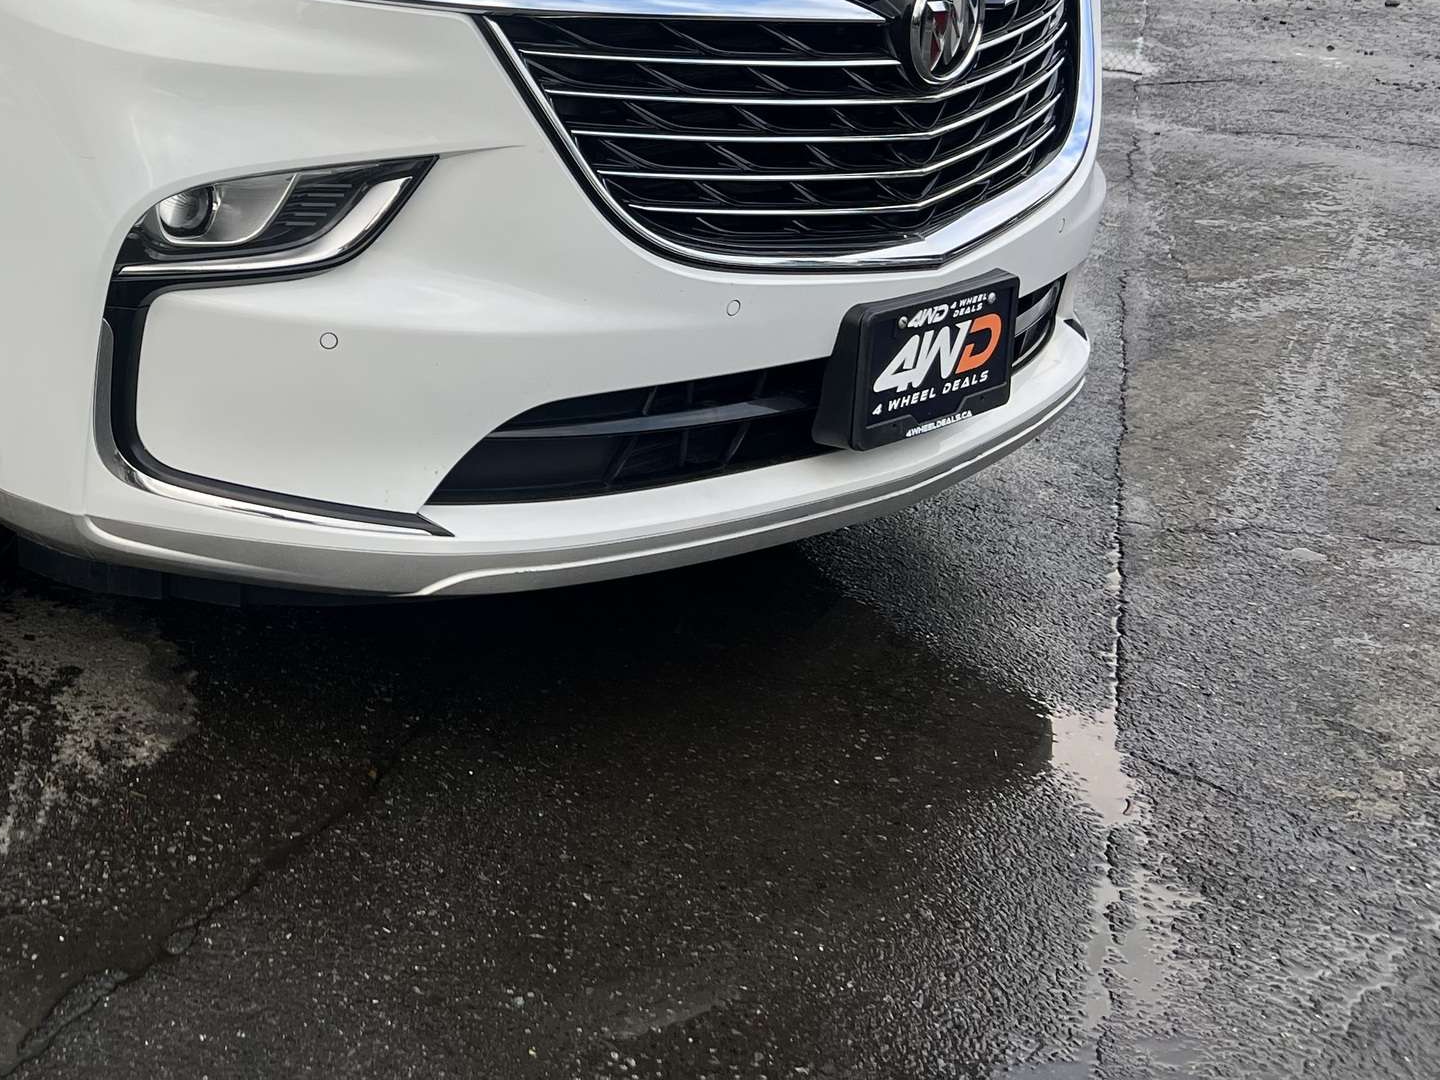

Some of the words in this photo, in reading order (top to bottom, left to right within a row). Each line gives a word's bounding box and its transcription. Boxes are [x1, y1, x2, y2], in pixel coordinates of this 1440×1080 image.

[907, 304, 949, 328] 4WD
[950, 301, 957, 309] 4
[959, 293, 987, 307] WHEEL
[952, 302, 984, 318] DEALS
[872, 312, 1003, 394] 4WD
[871, 403, 883, 416] 4
[887, 387, 937, 412] WHEEL
[941, 369, 990, 395] DEALS
[905, 409, 974, 438] 4WHEELDEALS.CA
